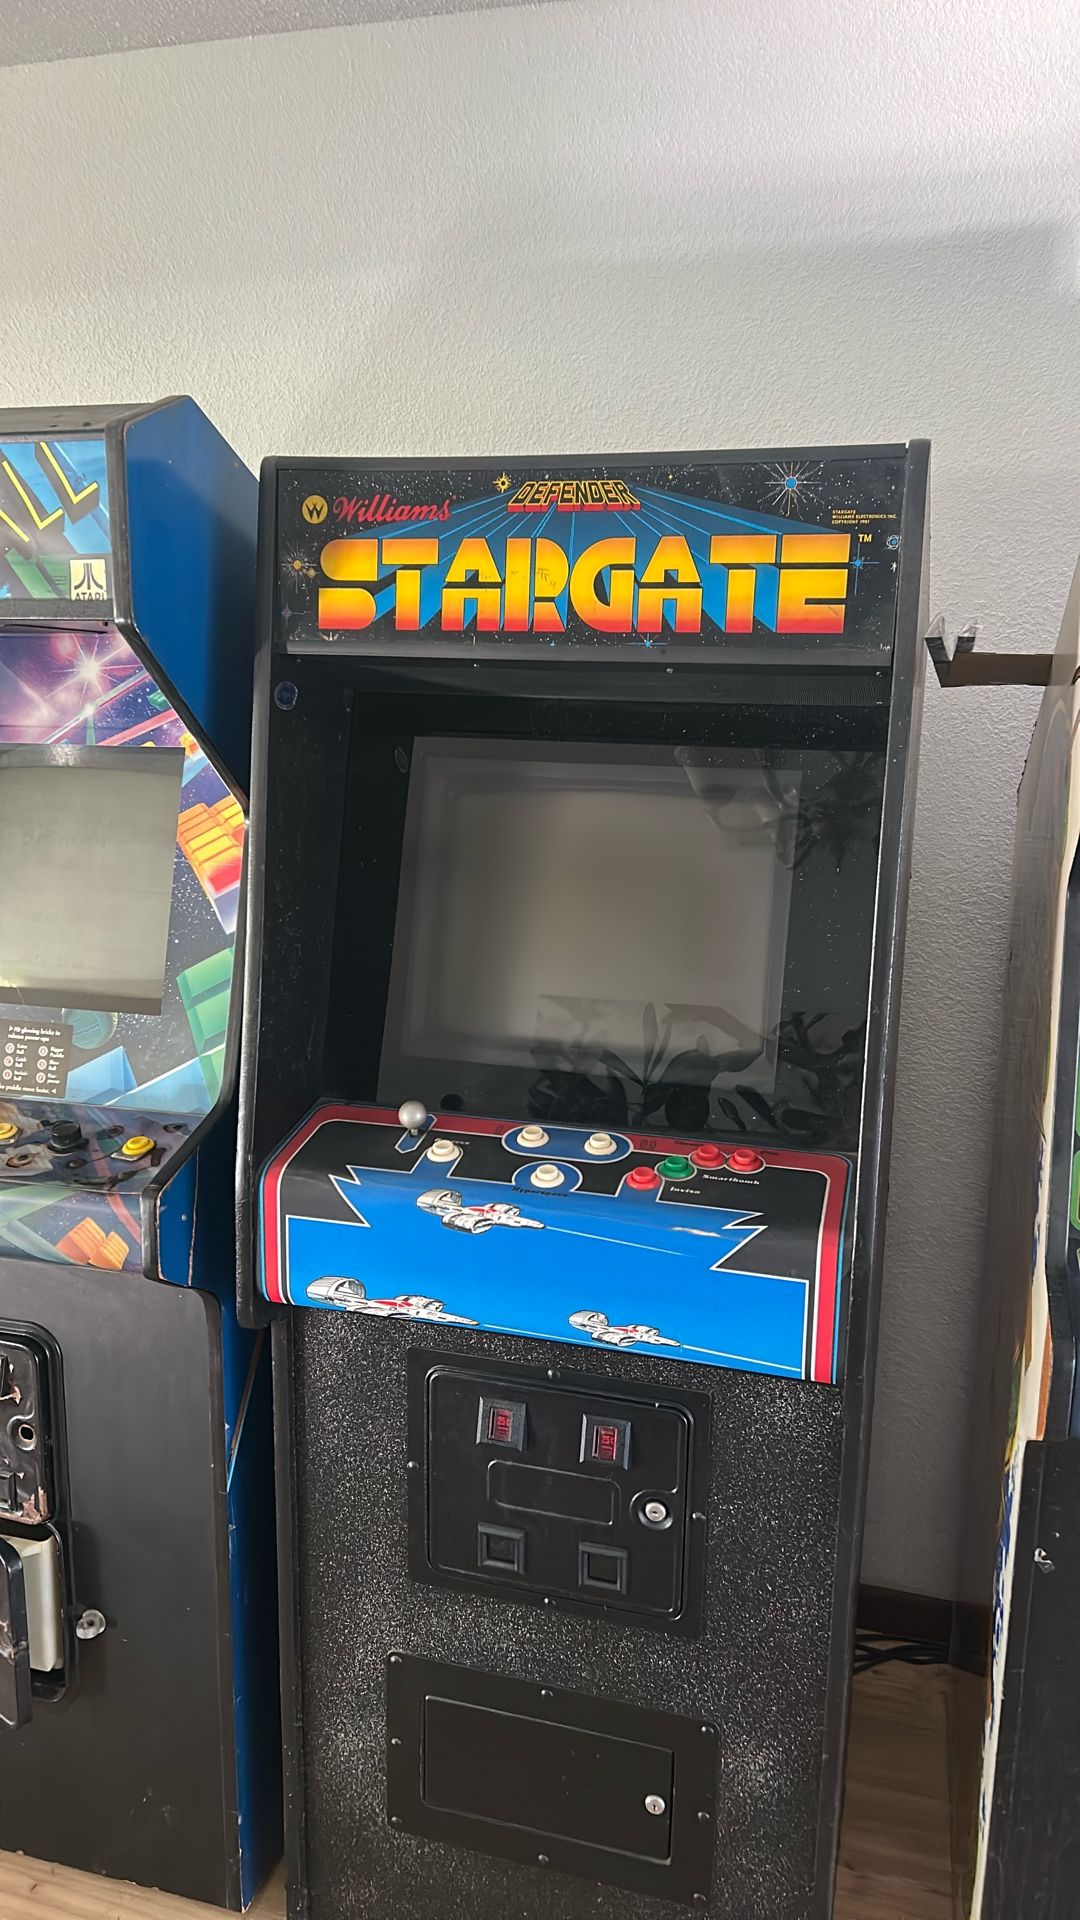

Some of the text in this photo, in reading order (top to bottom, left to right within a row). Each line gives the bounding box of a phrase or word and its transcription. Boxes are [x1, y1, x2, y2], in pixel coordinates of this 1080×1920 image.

[507, 480, 641, 512] DEFENDER
[333, 494, 451, 522] Williams
[857, 533, 872, 543] TM
[318, 534, 851, 634] STARGATE
[75, 592, 105, 601] ATARI
[702, 1174, 760, 1185] Smartbomb
[512, 1186, 569, 1197] Hyperspace
